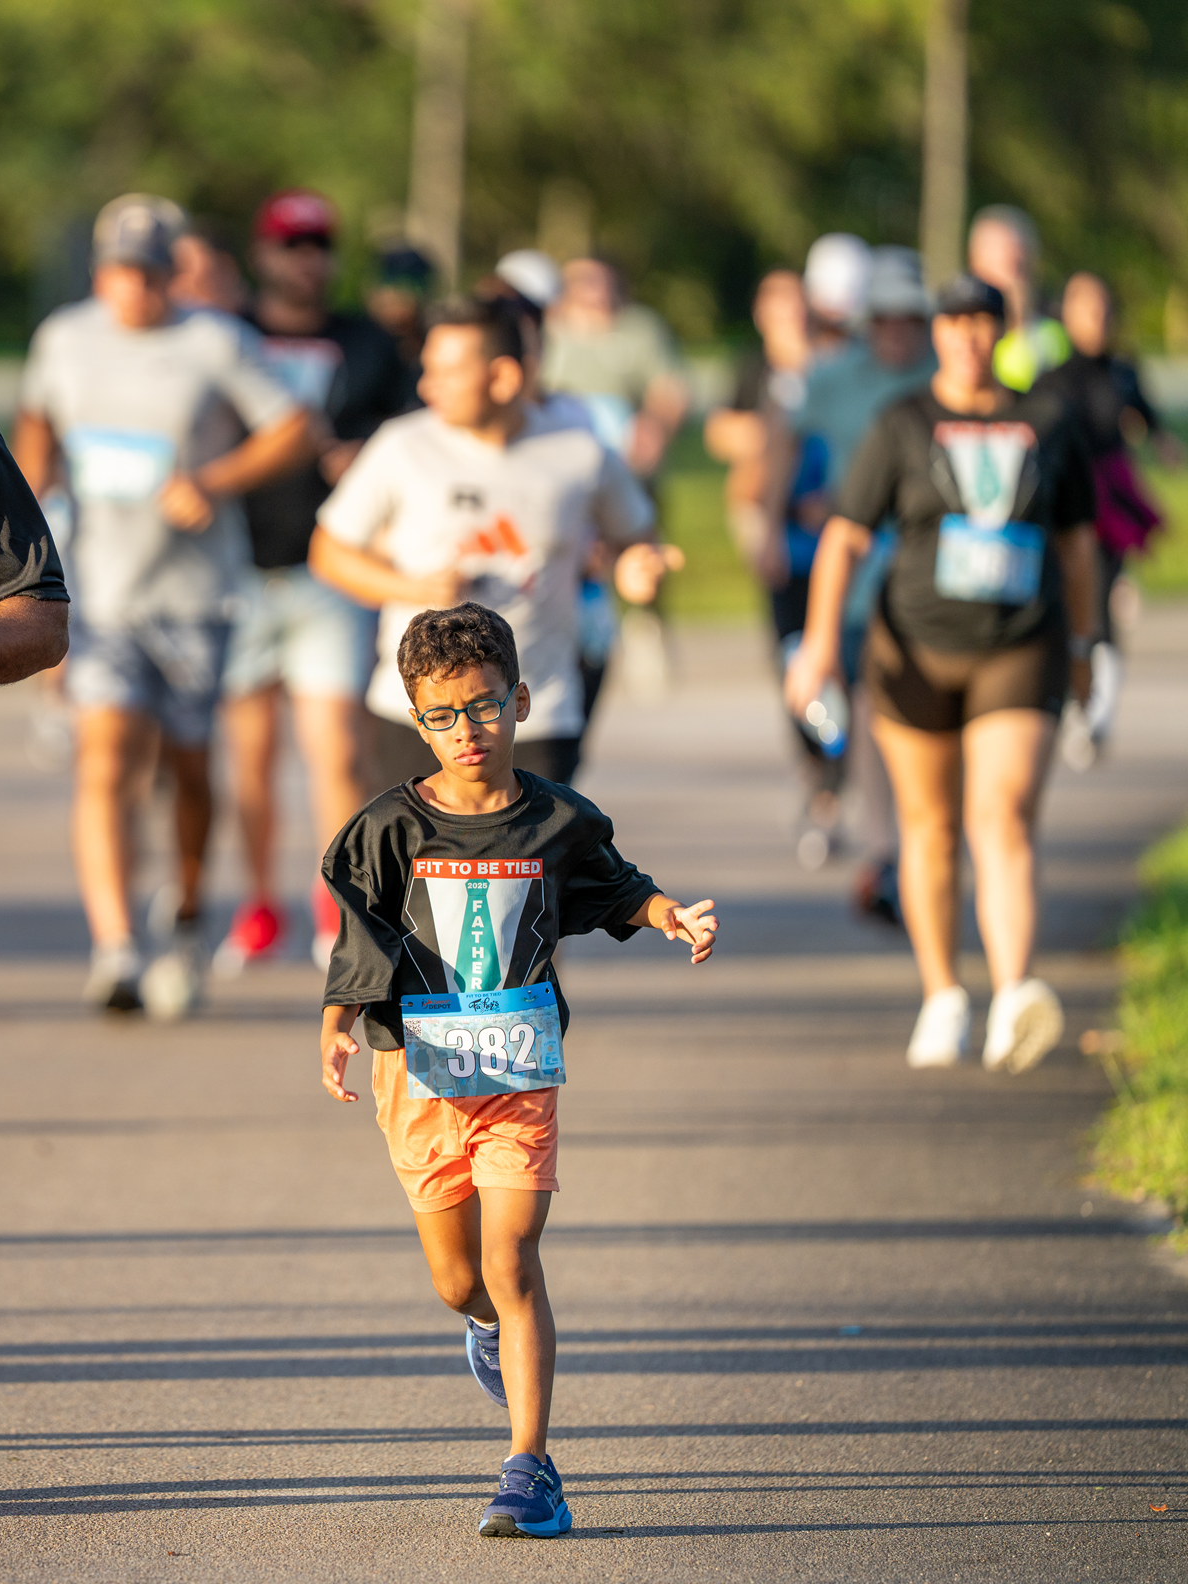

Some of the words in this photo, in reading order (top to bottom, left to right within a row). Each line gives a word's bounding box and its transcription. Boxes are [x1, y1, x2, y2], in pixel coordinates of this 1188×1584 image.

[416, 861, 444, 874] FIT
[448, 861, 472, 875] TO
[477, 862, 500, 875] BE
[504, 861, 541, 875] TIED
[467, 882, 488, 890] 2025
[471, 900, 485, 990] FATHER
[445, 1022, 538, 1079] 382
